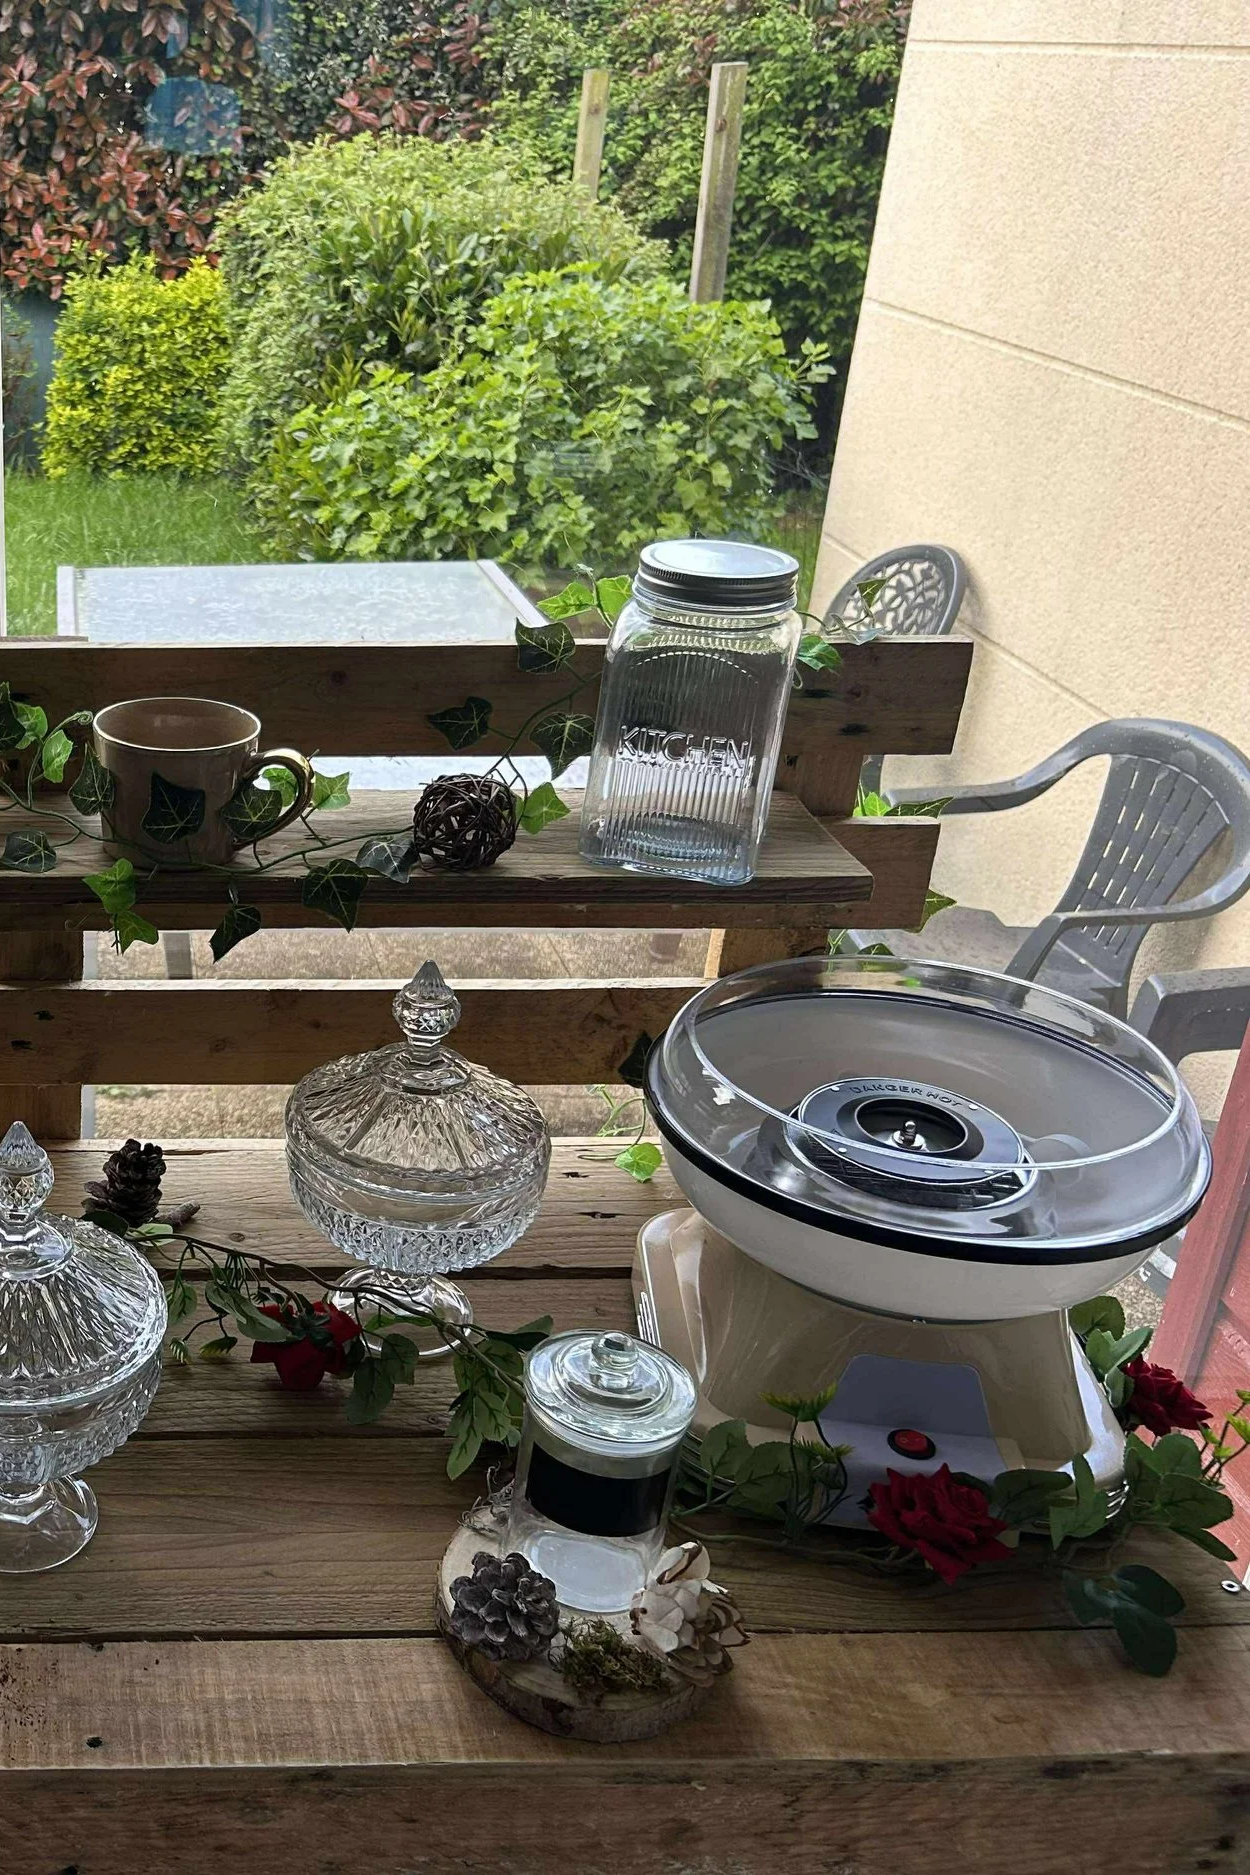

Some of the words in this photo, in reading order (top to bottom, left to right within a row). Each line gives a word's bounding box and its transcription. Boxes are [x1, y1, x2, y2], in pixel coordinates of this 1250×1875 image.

[617, 725, 750, 769] KITCHEN
[849, 1083, 923, 1096] DANGER
[926, 1090, 963, 1107] HOT
